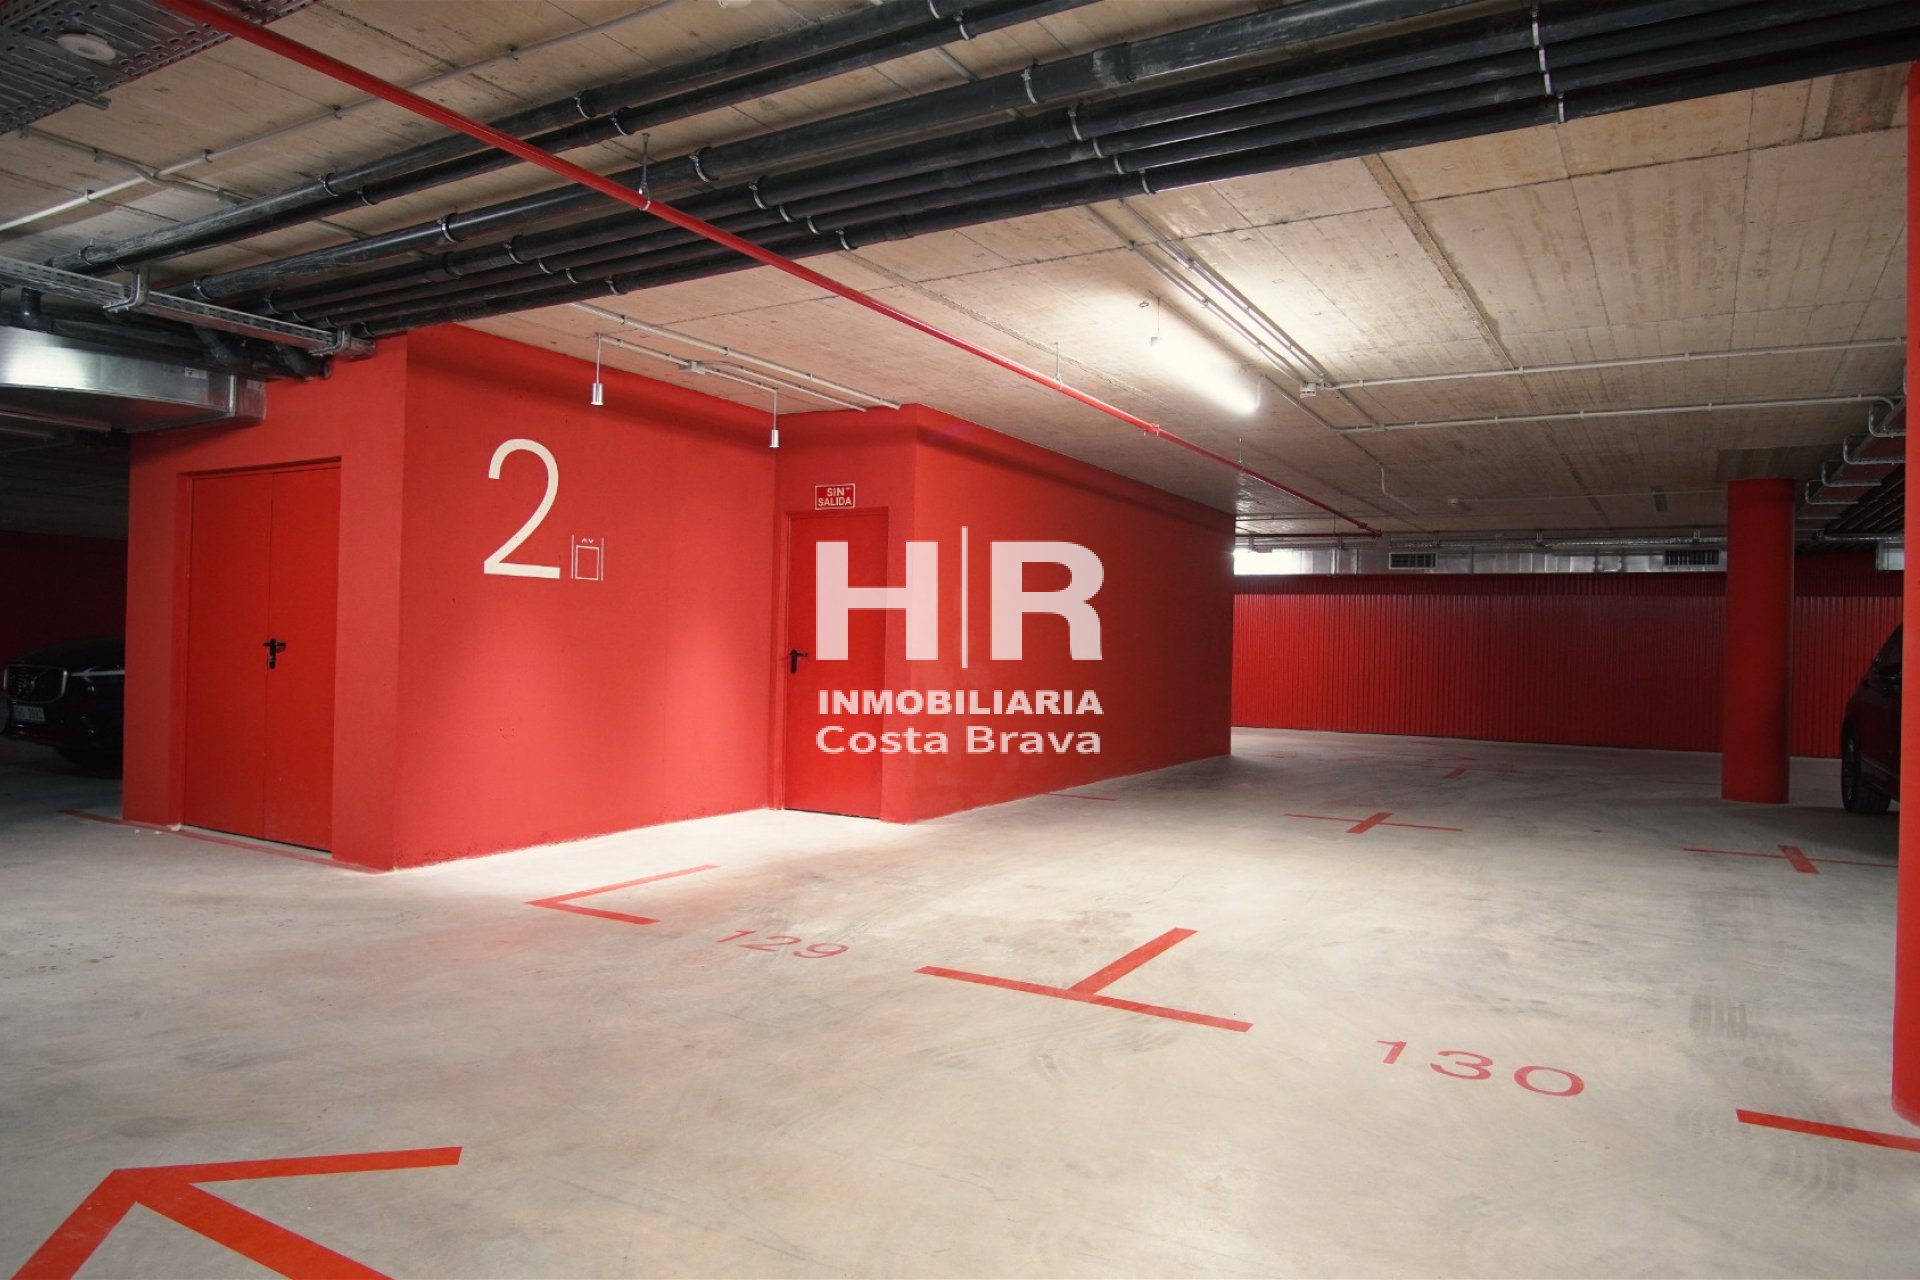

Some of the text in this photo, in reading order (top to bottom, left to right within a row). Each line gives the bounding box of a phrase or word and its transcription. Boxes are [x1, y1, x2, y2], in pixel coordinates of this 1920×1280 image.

[818, 497, 852, 506] SALIDA
[826, 487, 845, 497] SIN
[484, 438, 560, 579] 2
[716, 930, 849, 959] 129
[1376, 1040, 1585, 1097] 130
